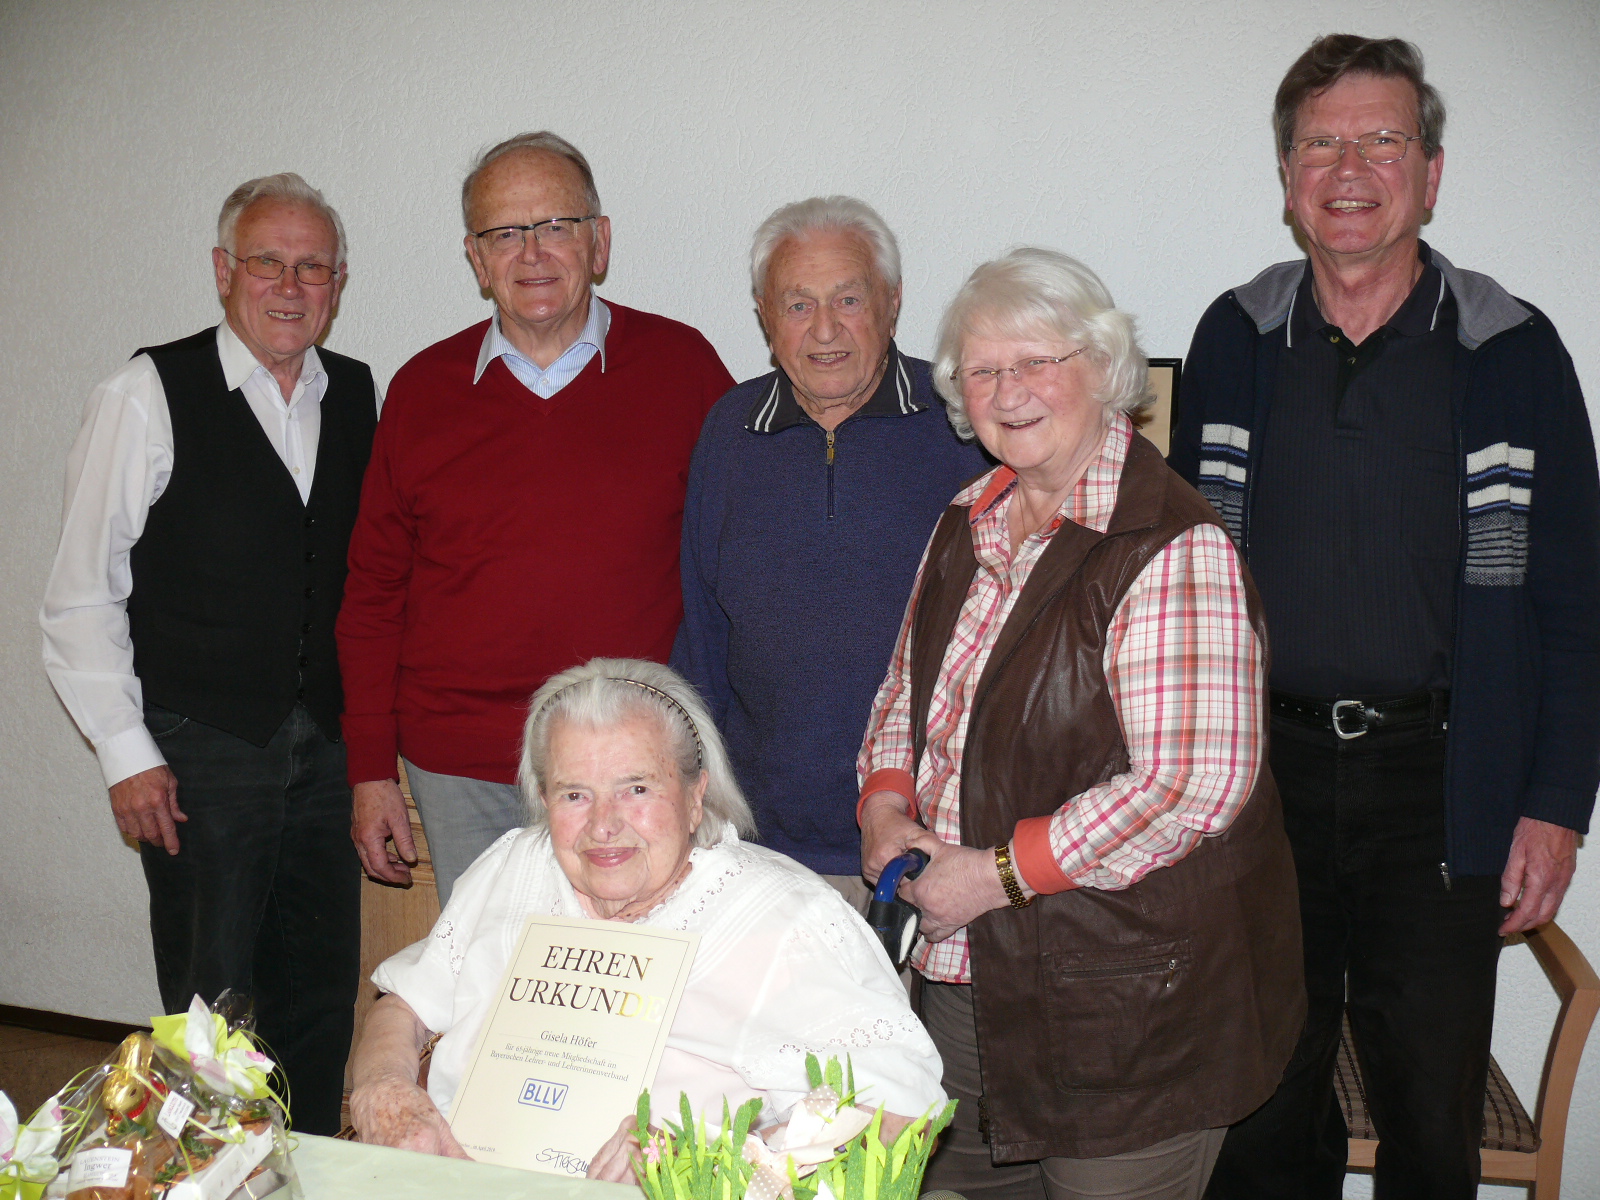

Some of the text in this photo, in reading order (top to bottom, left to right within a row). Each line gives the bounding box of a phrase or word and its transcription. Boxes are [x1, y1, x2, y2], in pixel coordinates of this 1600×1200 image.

[541, 945, 653, 981] EHREN
[509, 977, 665, 1024] URKUNDE
[540, 1030, 598, 1049] Gisela Höfer
[490, 1050, 629, 1082] Bayerischen Lehrer- und Lehrerinnenverband
[505, 1043, 515, 1051] für
[543, 1050, 560, 1058] treue
[561, 1051, 606, 1067] Mitgliedschaft
[607, 1059, 617, 1069] im
[523, 1083, 564, 1105] BLLV
[84, 1163, 112, 1172] Ingwer
